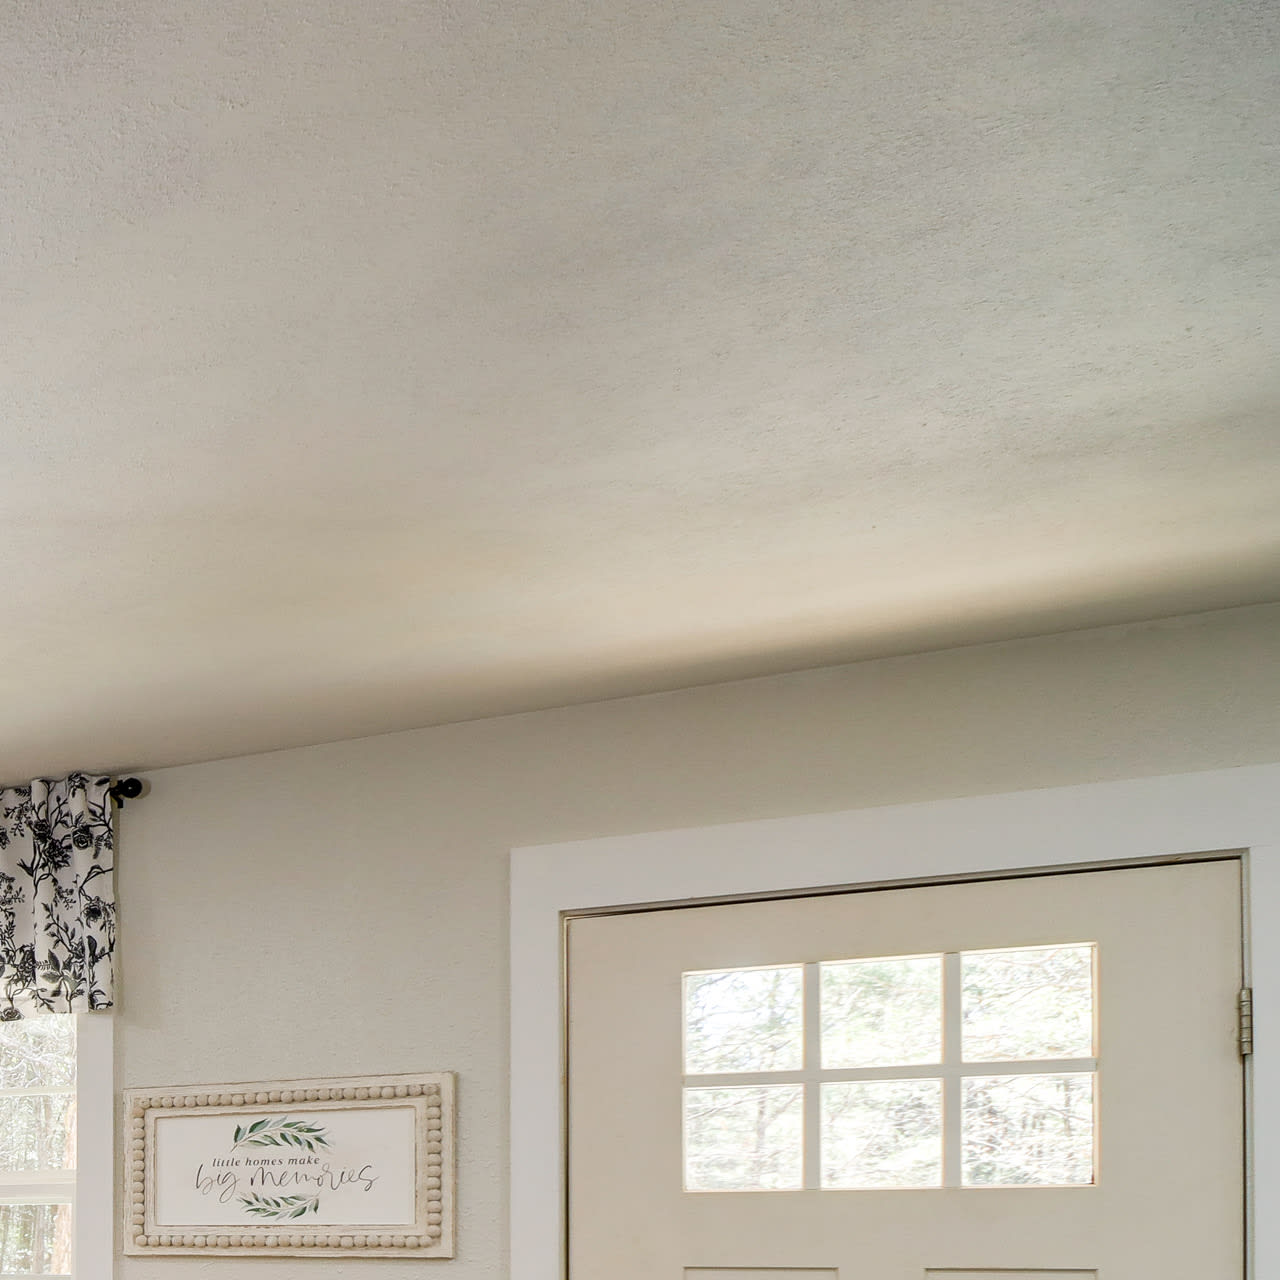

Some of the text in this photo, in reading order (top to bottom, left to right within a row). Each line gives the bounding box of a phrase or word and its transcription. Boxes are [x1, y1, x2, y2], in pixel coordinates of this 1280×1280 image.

[212, 1155, 320, 1167] little homes make
[196, 1164, 241, 1203] big
